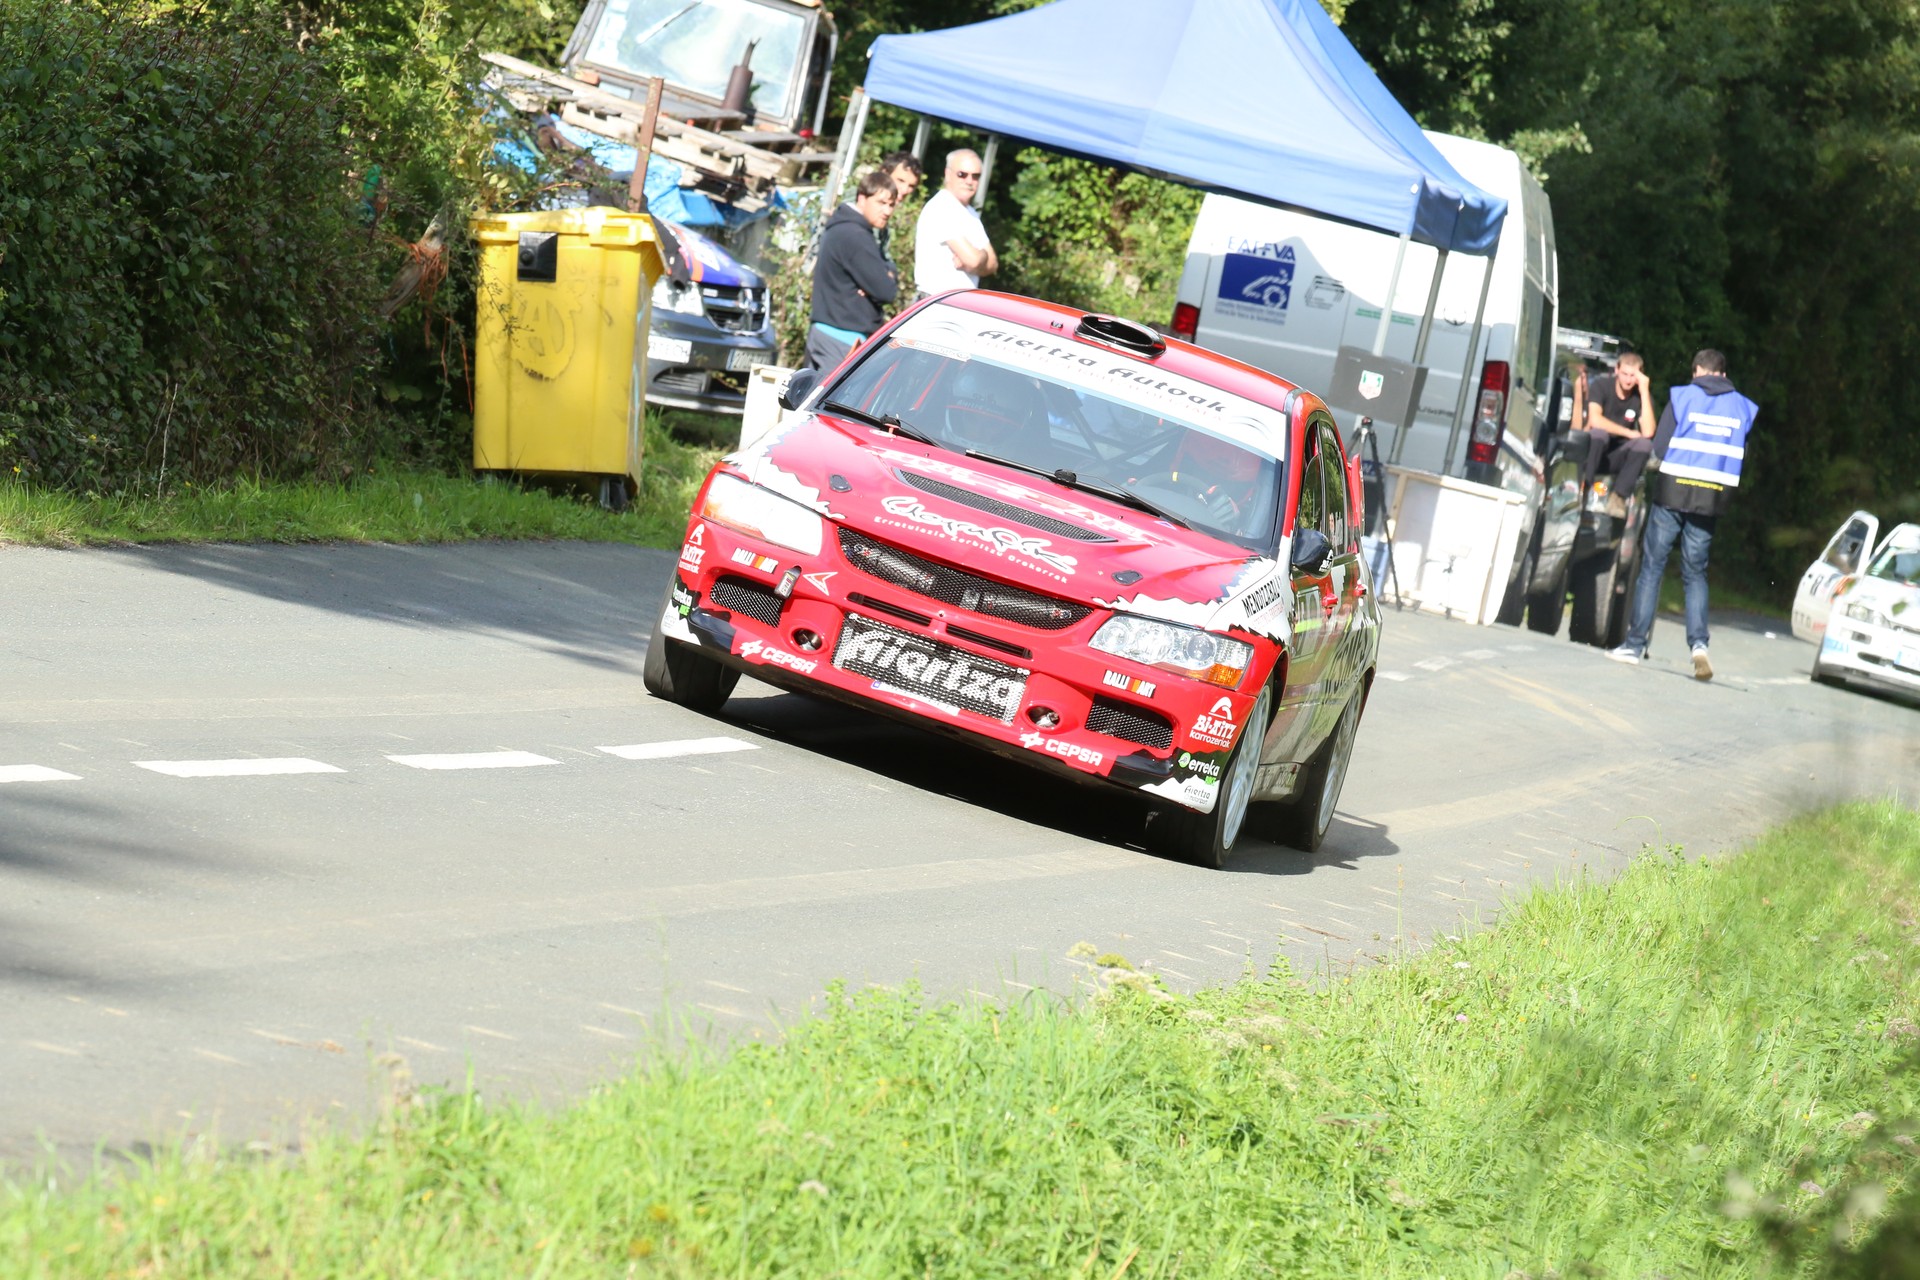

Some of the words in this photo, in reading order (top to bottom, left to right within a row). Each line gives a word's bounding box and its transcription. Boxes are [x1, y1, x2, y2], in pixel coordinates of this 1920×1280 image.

[978, 329, 1097, 368] Aiertza
[1107, 367, 1227, 413] Autoak
[761, 647, 818, 674] CEPSA
[842, 628, 1026, 706] Aiertza
[1045, 738, 1104, 767] CEPSA
[1189, 730, 1231, 748] karrozeriak
[1189, 759, 1220, 777] erreka
[1184, 785, 1211, 799] Aiertza
